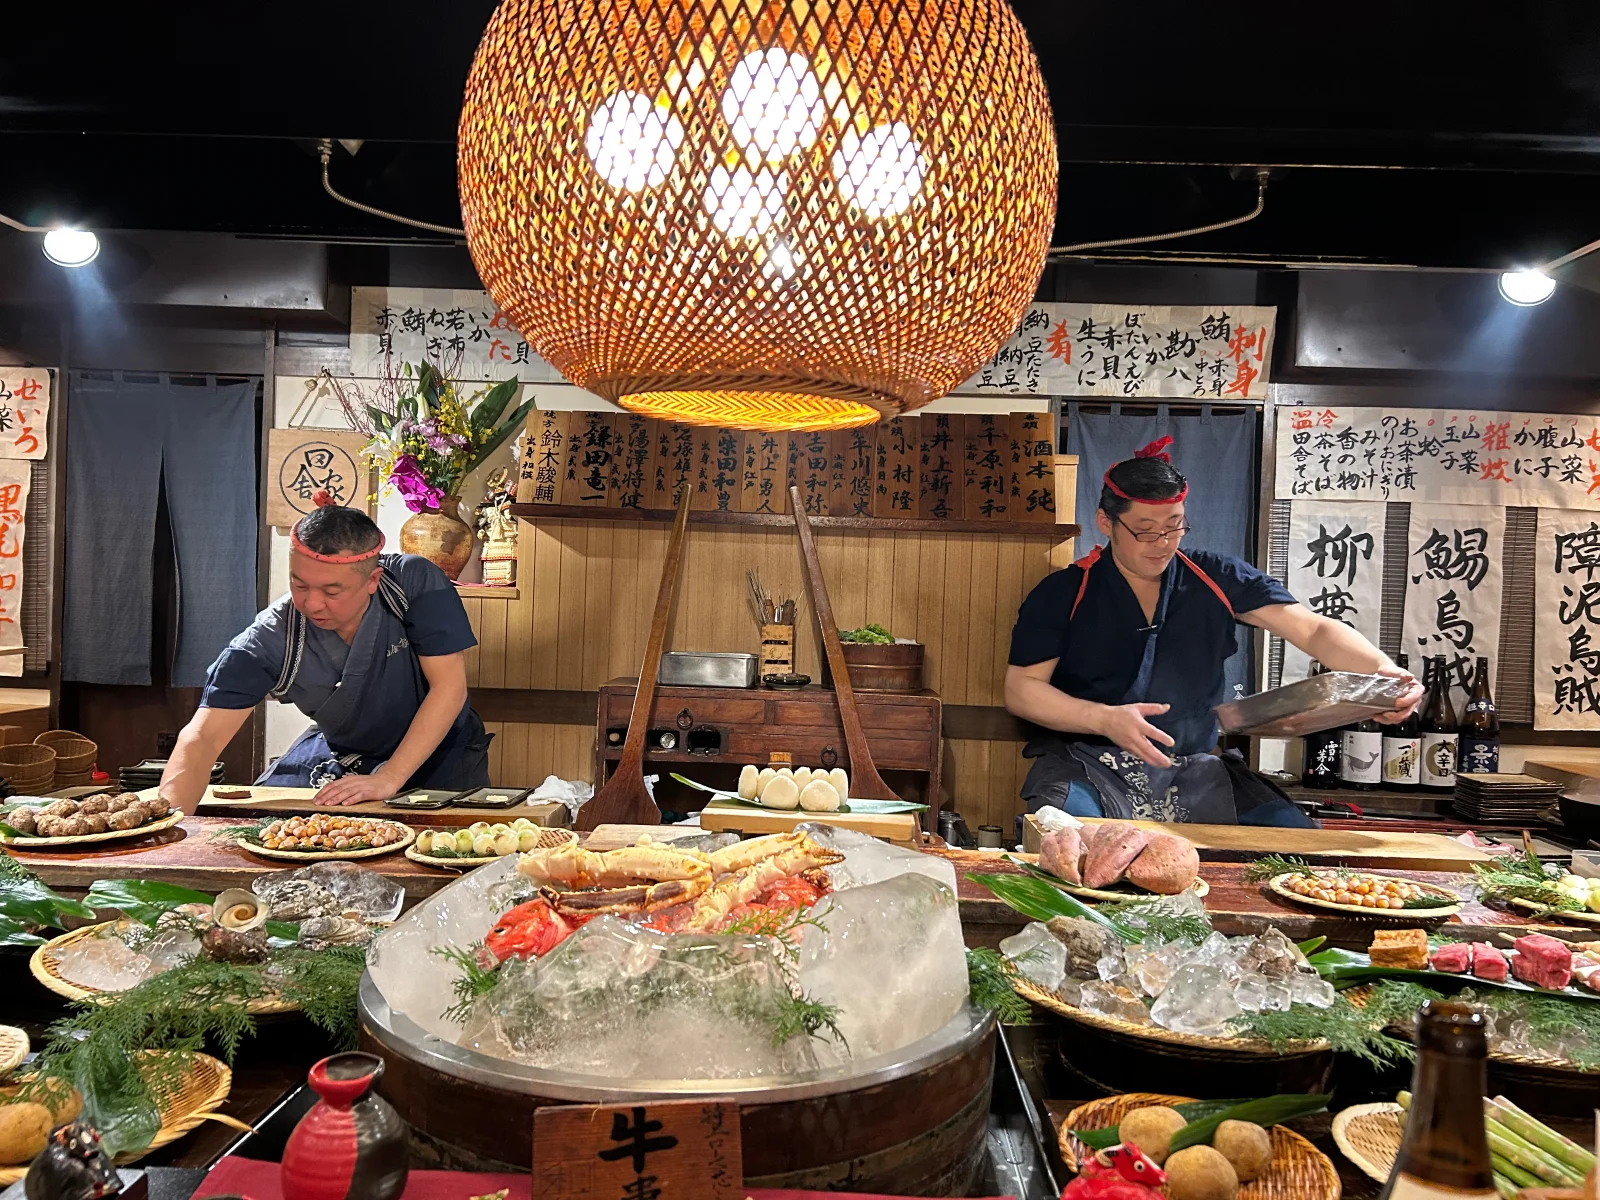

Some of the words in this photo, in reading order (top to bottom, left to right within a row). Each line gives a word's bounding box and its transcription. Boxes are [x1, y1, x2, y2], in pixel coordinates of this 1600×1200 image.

[376, 306, 397, 354] 赤貝
[399, 306, 426, 336] 鮪
[426, 308, 446, 358] ねぎ
[446, 307, 466, 351] 若布
[468, 312, 490, 342] いか
[1046, 318, 1071, 365] 肴
[1195, 311, 1230, 343] 鮪
[1076, 317, 1097, 386] 生うに
[1099, 326, 1122, 380] 赤貝
[1142, 333, 1165, 365] いか
[1165, 328, 1196, 381] 勘八
[1223, 323, 1266, 397] 刺身
[1193, 358, 1208, 397] 中とろ
[1209, 358, 1229, 397] 赤身
[14, 378, 42, 453] せいろ
[1289, 431, 1314, 495] 田舎そば
[1313, 432, 1337, 491] 茶そば
[1335, 426, 1360, 490] 香の物
[1360, 430, 1380, 491] みそ汁
[1395, 417, 1419, 490] お茶漬
[1418, 435, 1444, 457] 蛤
[1440, 426, 1461, 470] 玉子
[1459, 423, 1480, 474] 山菜
[1479, 421, 1512, 483] 雑炊
[1514, 427, 1536, 475] かに
[1559, 427, 1587, 484] 山菜
[1437, 739, 1451, 778] 大辛口
